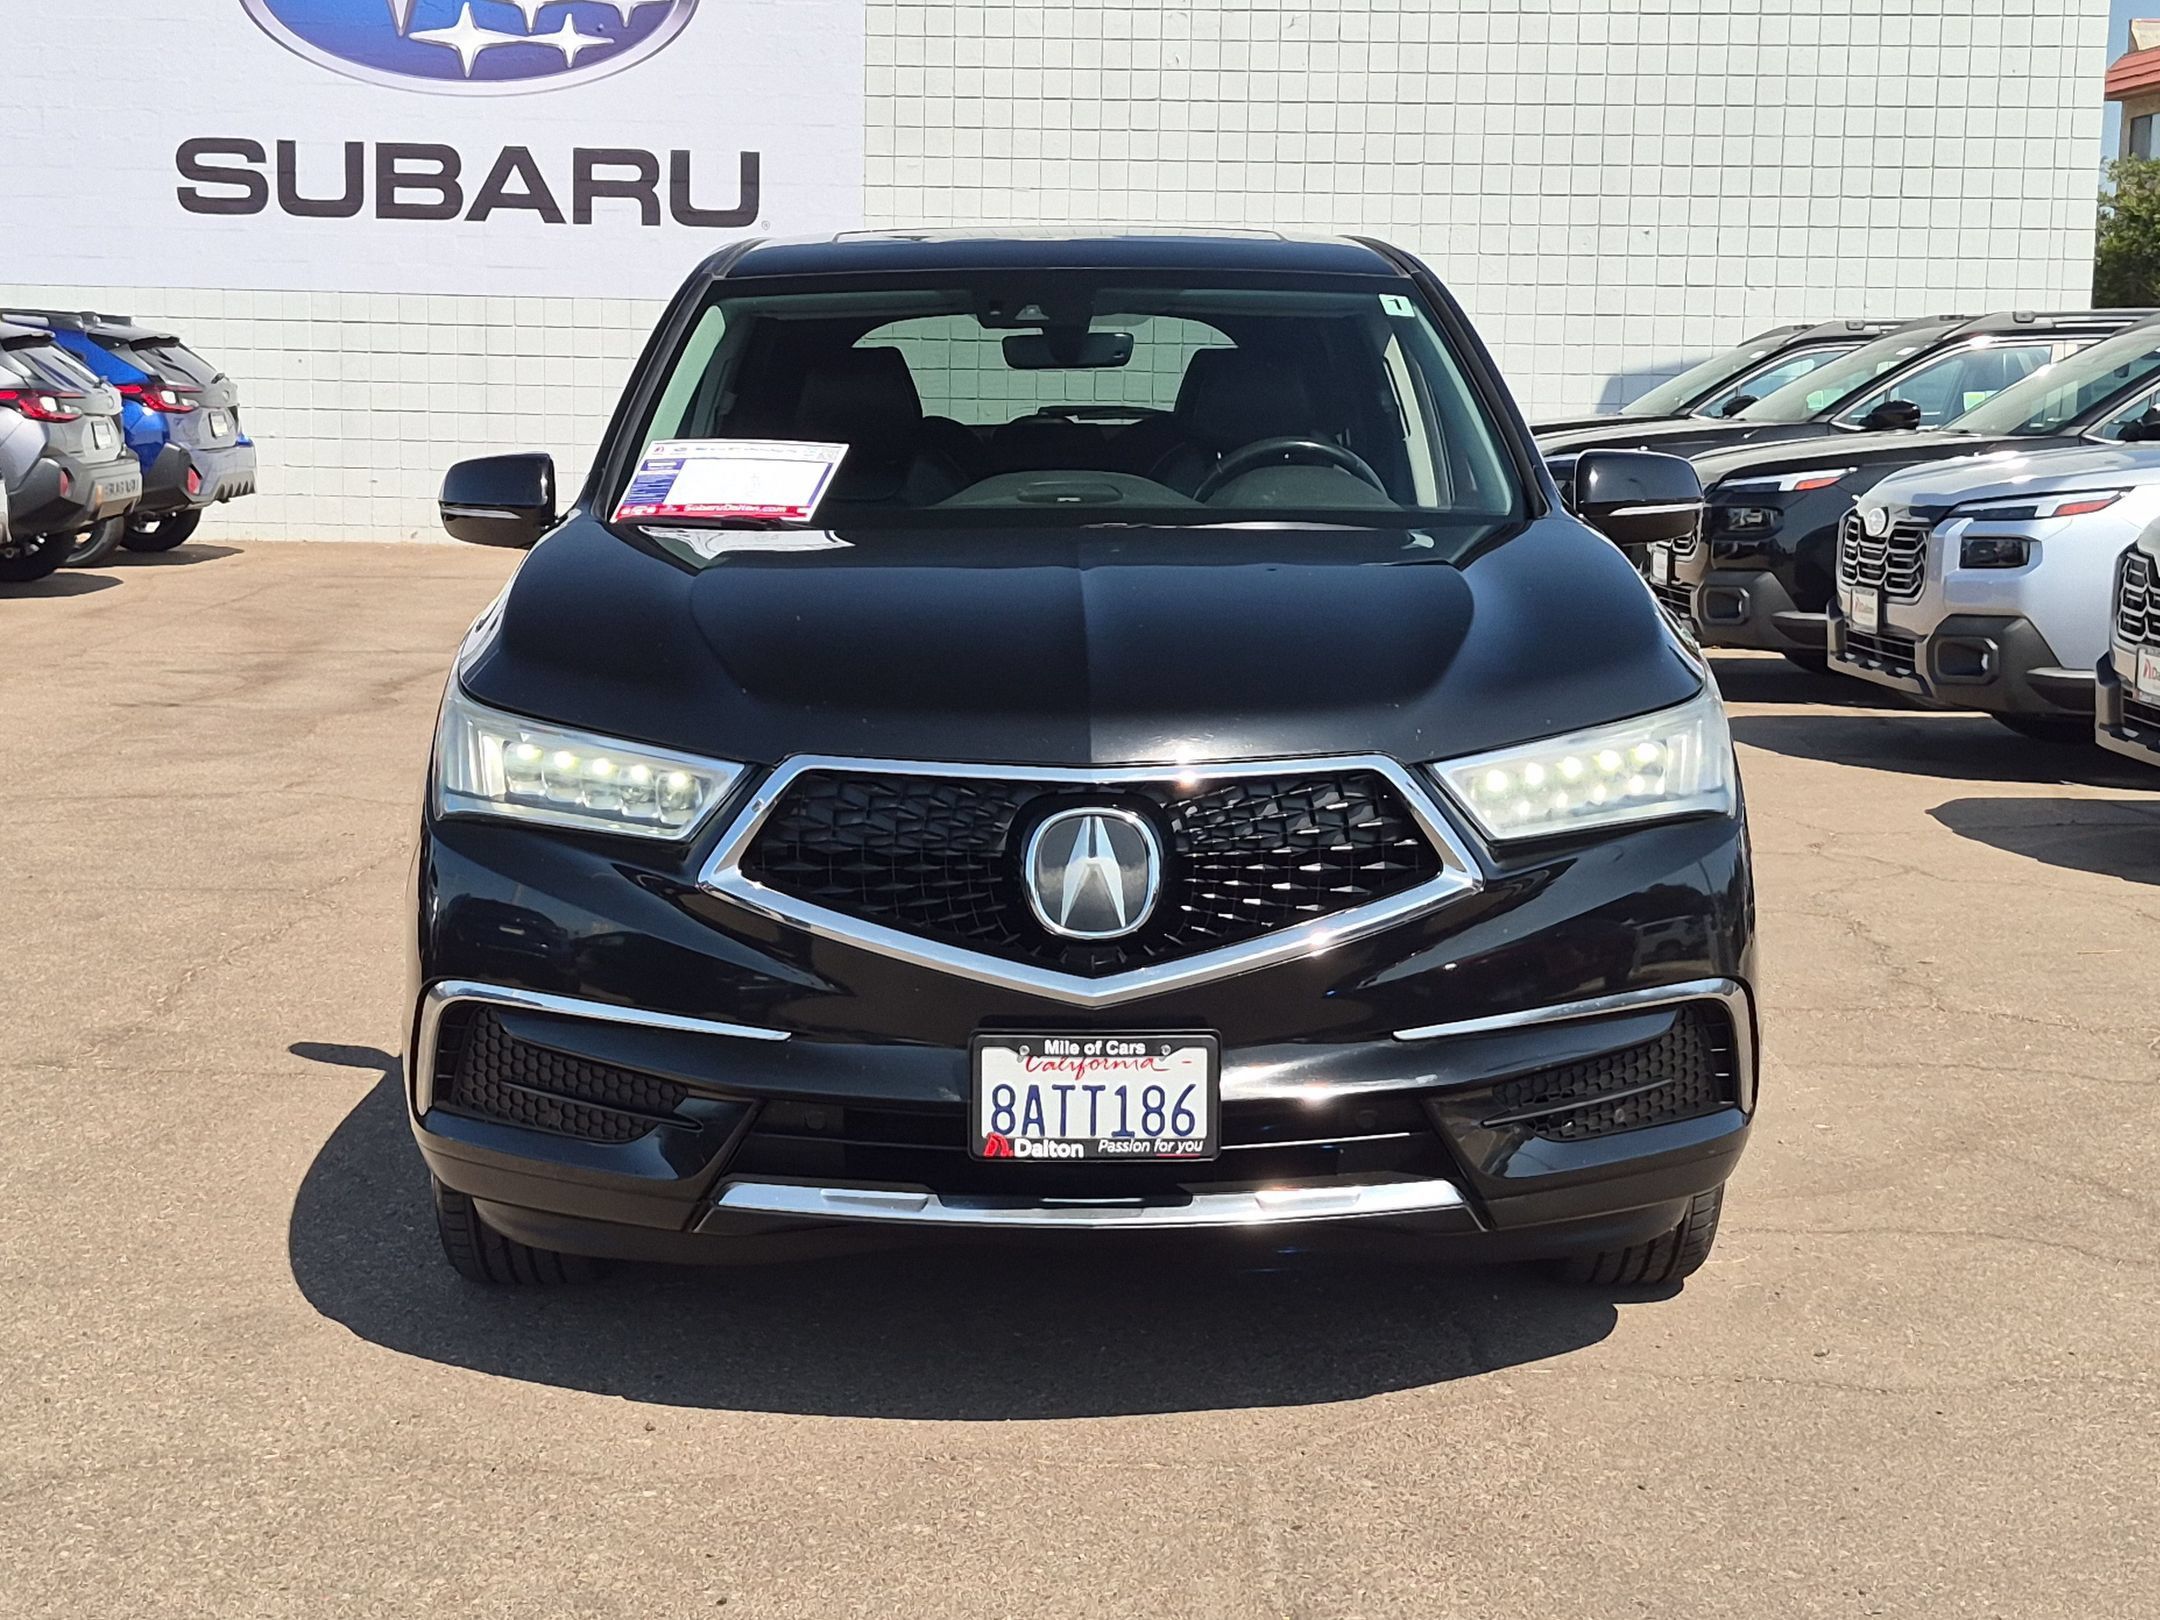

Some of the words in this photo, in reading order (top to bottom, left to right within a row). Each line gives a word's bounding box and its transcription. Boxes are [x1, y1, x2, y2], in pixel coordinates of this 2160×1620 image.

[175, 136, 760, 228] SUBARU
[1044, 1039, 1080, 1055] Mile
[1084, 1039, 1103, 1055] of
[1106, 1039, 1147, 1055] Cars
[1025, 1055, 1171, 1081] California
[991, 1083, 1197, 1137] 8ATT186
[1014, 1138, 1085, 1159] Dalton
[1097, 1139, 1151, 1153] Passion
[1153, 1138, 1173, 1153] for
[1176, 1140, 1204, 1154] you
